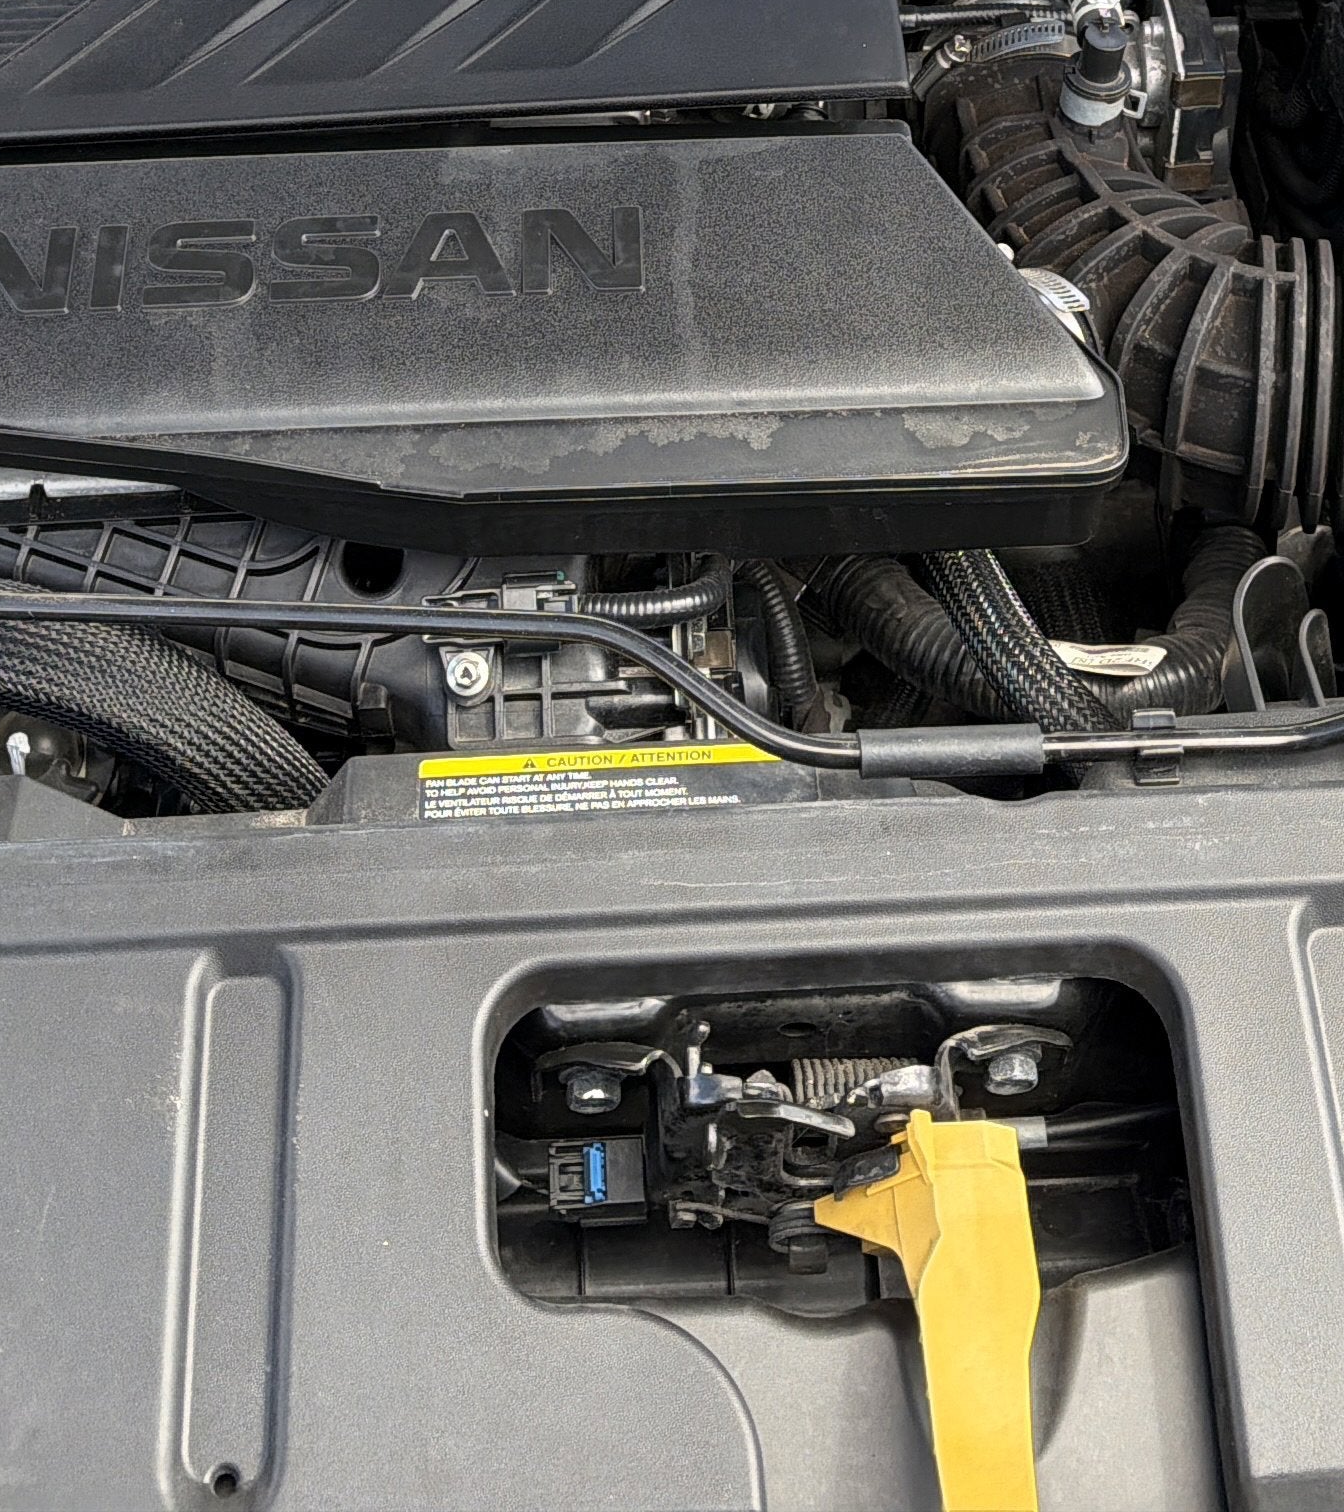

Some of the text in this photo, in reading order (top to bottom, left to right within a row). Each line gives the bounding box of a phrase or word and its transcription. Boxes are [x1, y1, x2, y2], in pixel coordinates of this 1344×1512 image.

[546, 754, 612, 768] CAUTION
[630, 750, 712, 764] ATTENTION
[424, 789, 438, 798] TO
[440, 787, 466, 796] HELP
[467, 785, 497, 795] AVOID
[498, 783, 550, 794] PERSONAL
[609, 778, 644, 787] HANDS
[645, 776, 679, 786] CLEAR.
[425, 771, 592, 788] FAN BLADE CAN START AT ANY TIME.
[424, 800, 437, 809] LE
[438, 796, 500, 808] VENTILATEUR
[501, 794, 538, 804] RISQUE
[540, 793, 553, 802] DE
[556, 790, 607, 801] DÉMARRER
[617, 789, 643, 798] TOUT
[644, 787, 688, 798] MOMENT.
[424, 809, 453, 819] POUR
[455, 806, 487, 817] ÉVITER
[488, 805, 520, 815] TOUTE
[574, 801, 590, 811] NE
[591, 800, 610, 810] PAS
[611, 799, 625, 809] EN
[626, 797, 687, 808] APPROCHER
[688, 795, 706, 805] LES
[707, 794, 741, 804] MAINS.
